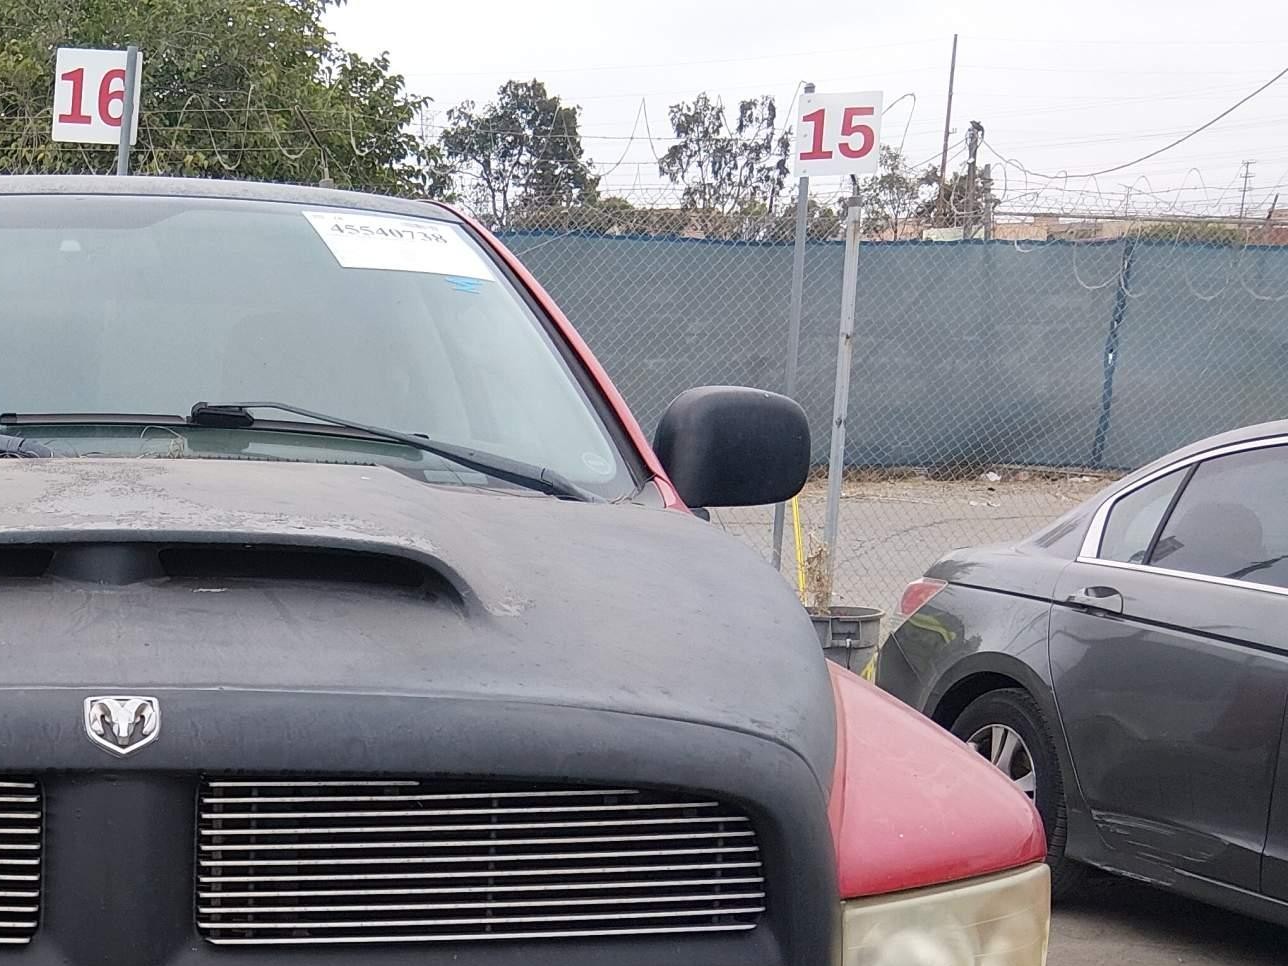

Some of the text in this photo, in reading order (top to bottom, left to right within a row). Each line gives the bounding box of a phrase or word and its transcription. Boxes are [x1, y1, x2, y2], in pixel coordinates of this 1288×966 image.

[58, 68, 133, 127] 16
[799, 106, 875, 161] 15
[330, 223, 448, 244] 45540738
